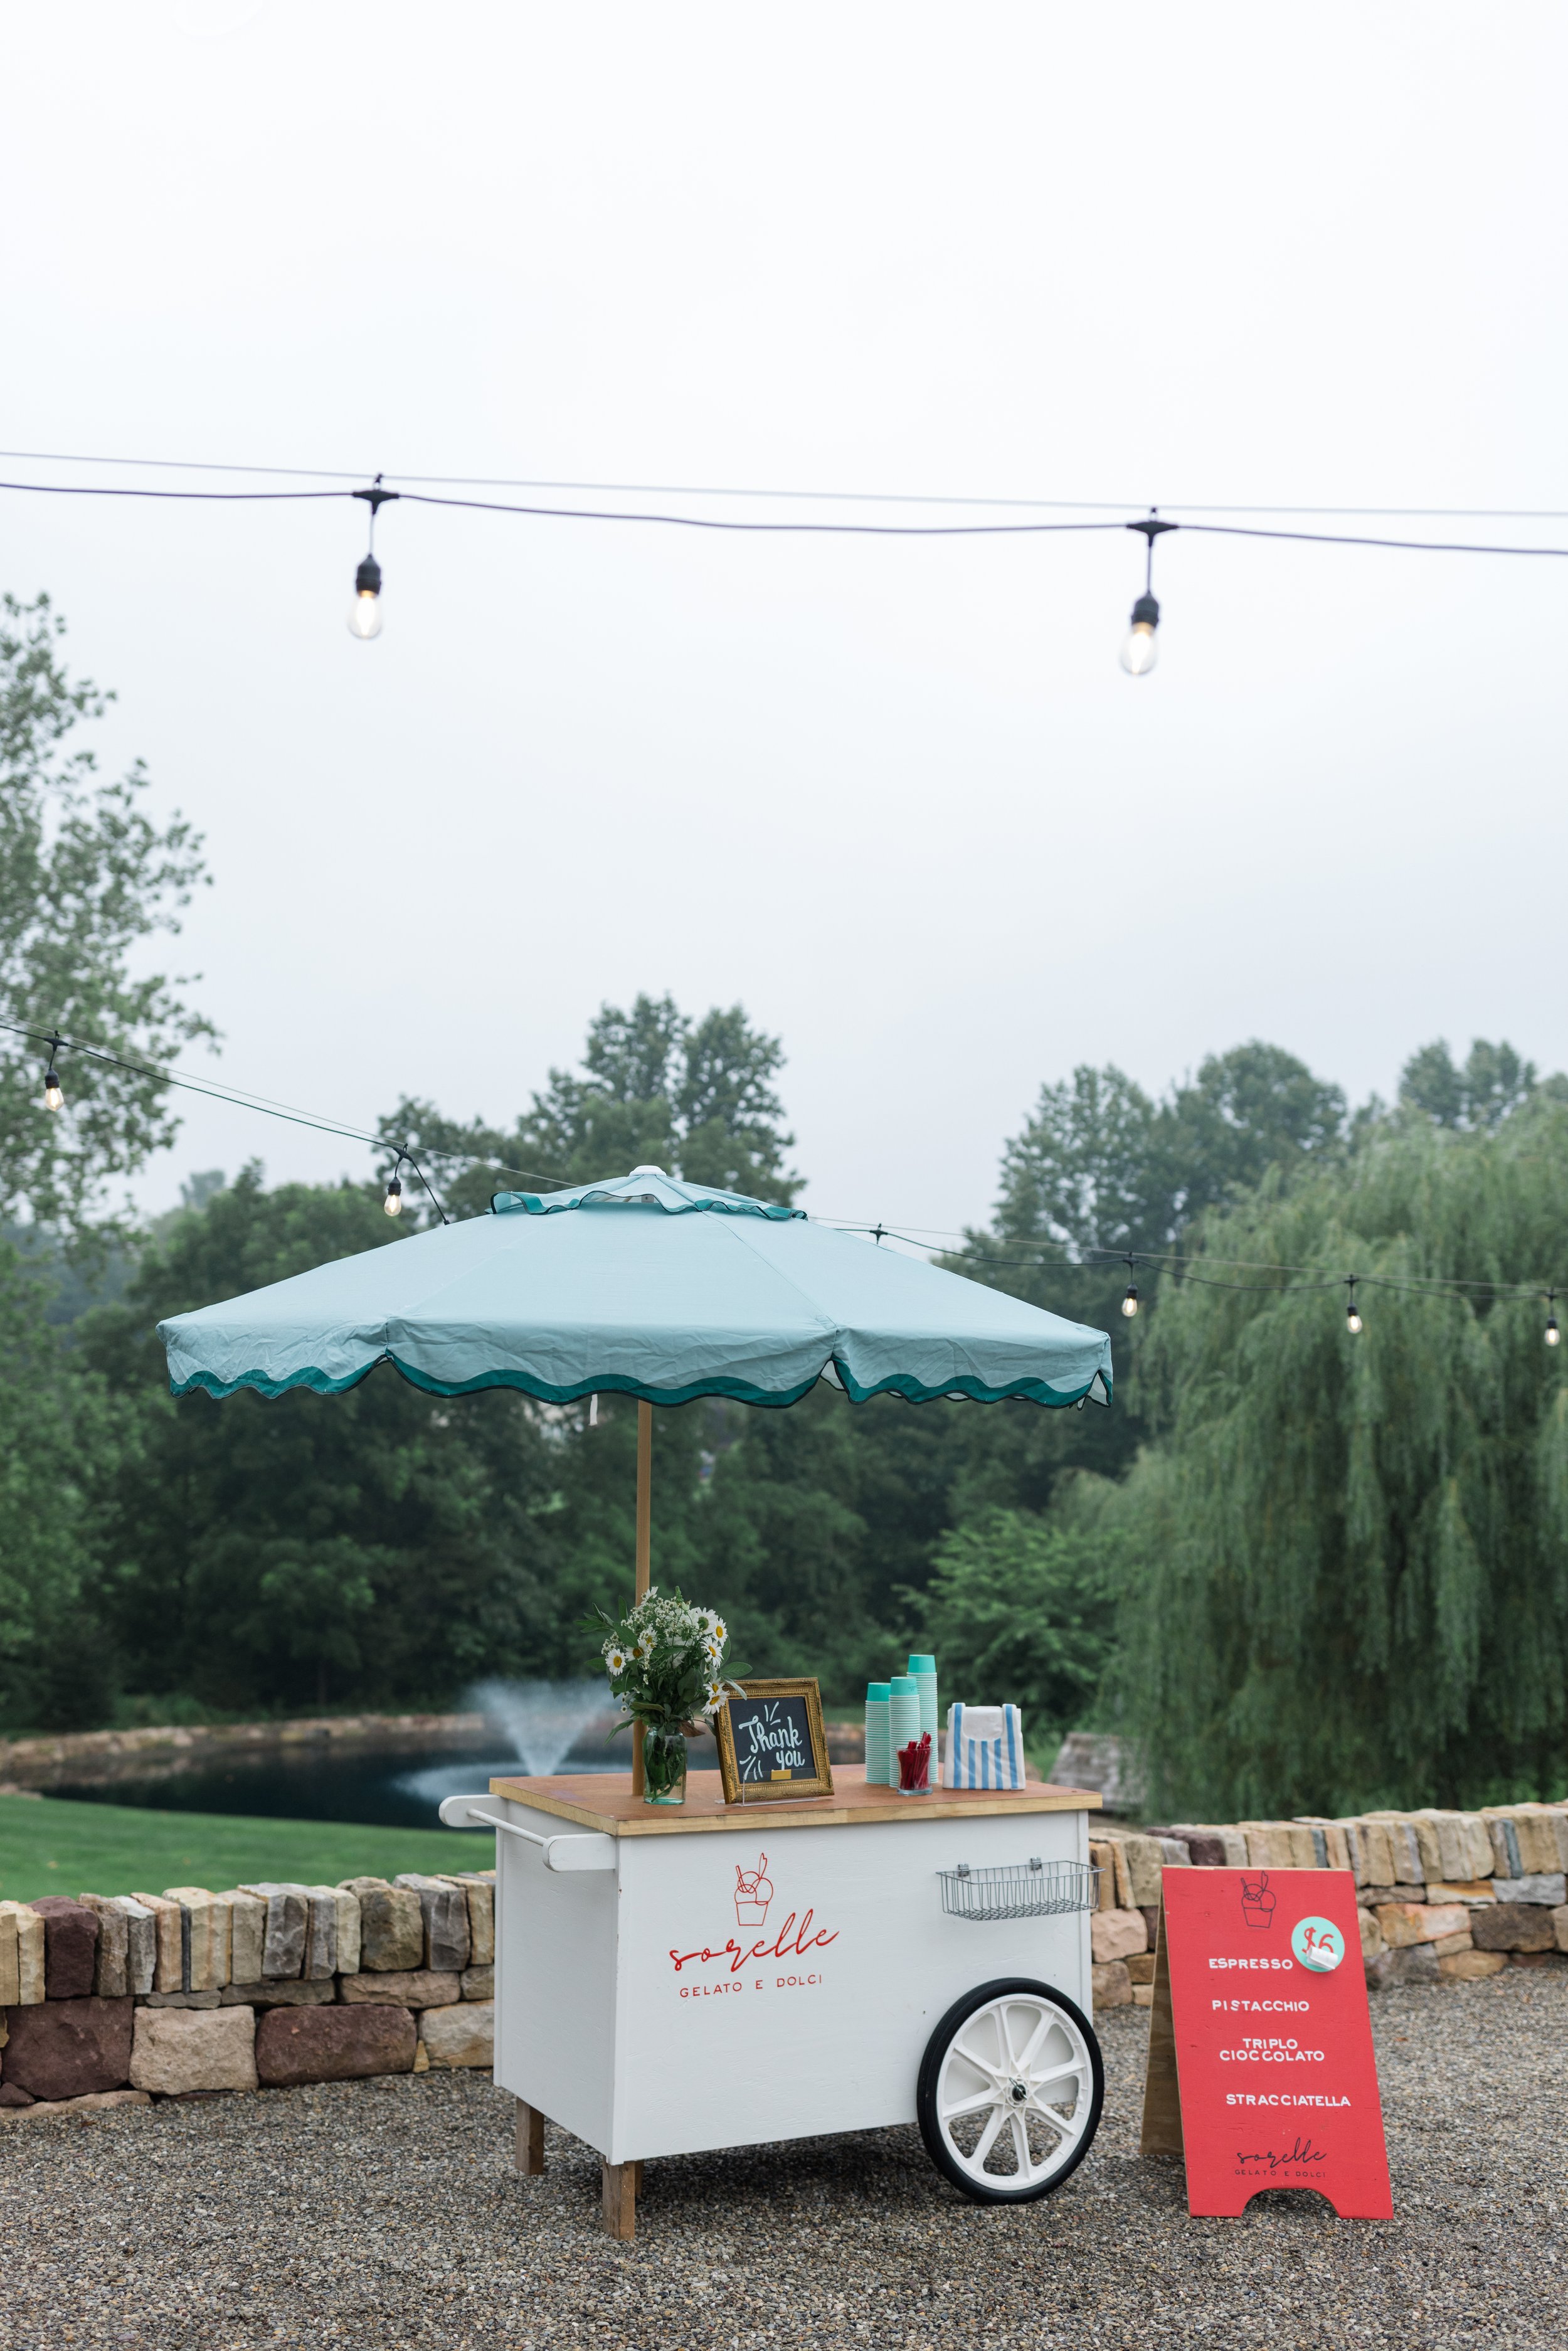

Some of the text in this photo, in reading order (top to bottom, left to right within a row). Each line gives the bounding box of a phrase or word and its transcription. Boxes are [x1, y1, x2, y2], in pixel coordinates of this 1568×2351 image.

[739, 1716, 803, 1754] Thank
[776, 1750, 805, 1770] you
[669, 1908, 840, 1973] sorelle
[1302, 1926, 1334, 1953] $6
[1209, 1958, 1293, 1970] ESPRESSO
[679, 1974, 822, 1998] GELATO E DOLCI
[1212, 2000, 1310, 2012] PISTACCHIO
[1242, 2038, 1298, 2049] TRIPLO
[1219, 2050, 1325, 2062] CIOCCOLATO
[1226, 2094, 1352, 2107] STRACCIATELLA
[1237, 2137, 1327, 2168] sorelle
